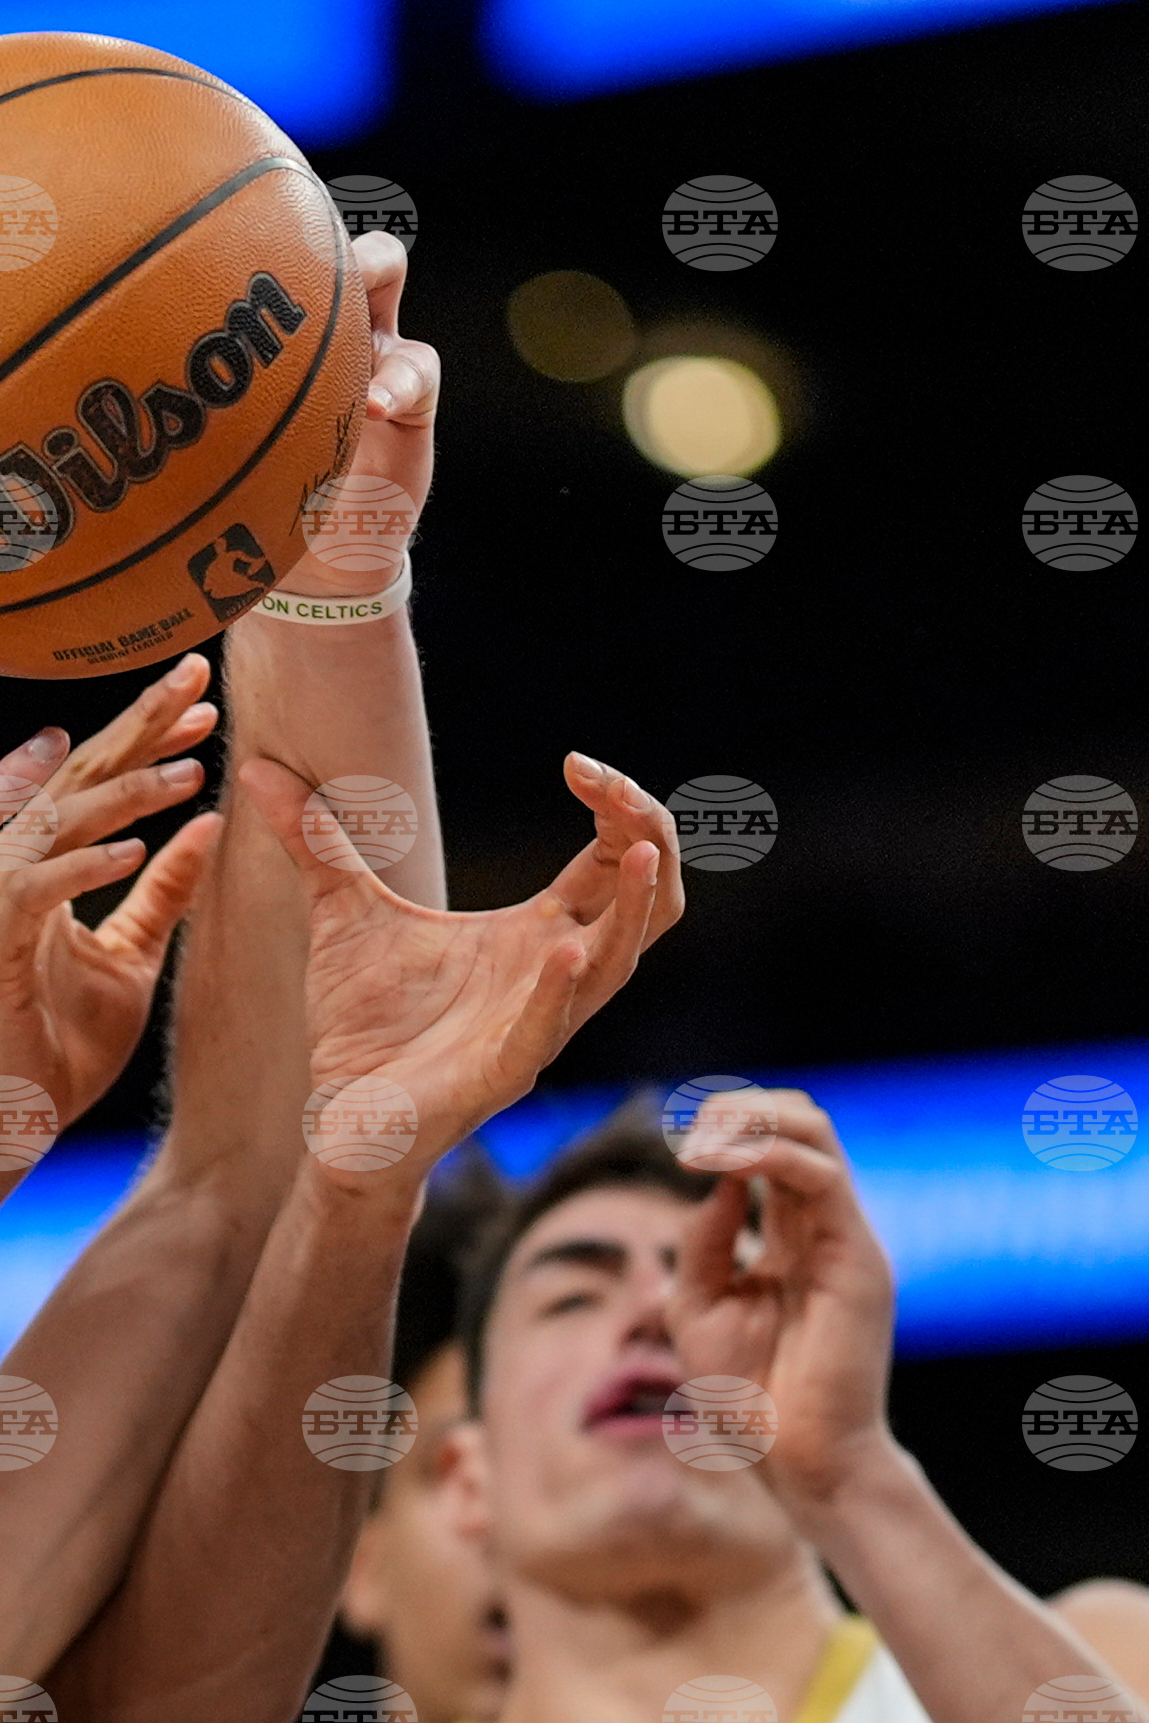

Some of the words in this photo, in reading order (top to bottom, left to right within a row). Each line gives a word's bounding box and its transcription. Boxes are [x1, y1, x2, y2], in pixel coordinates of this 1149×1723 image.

[296, 600, 383, 619] CELTICS
[53, 640, 115, 662] OFFICIAL
[117, 624, 161, 647] GAME
[158, 608, 195, 632] BALL
